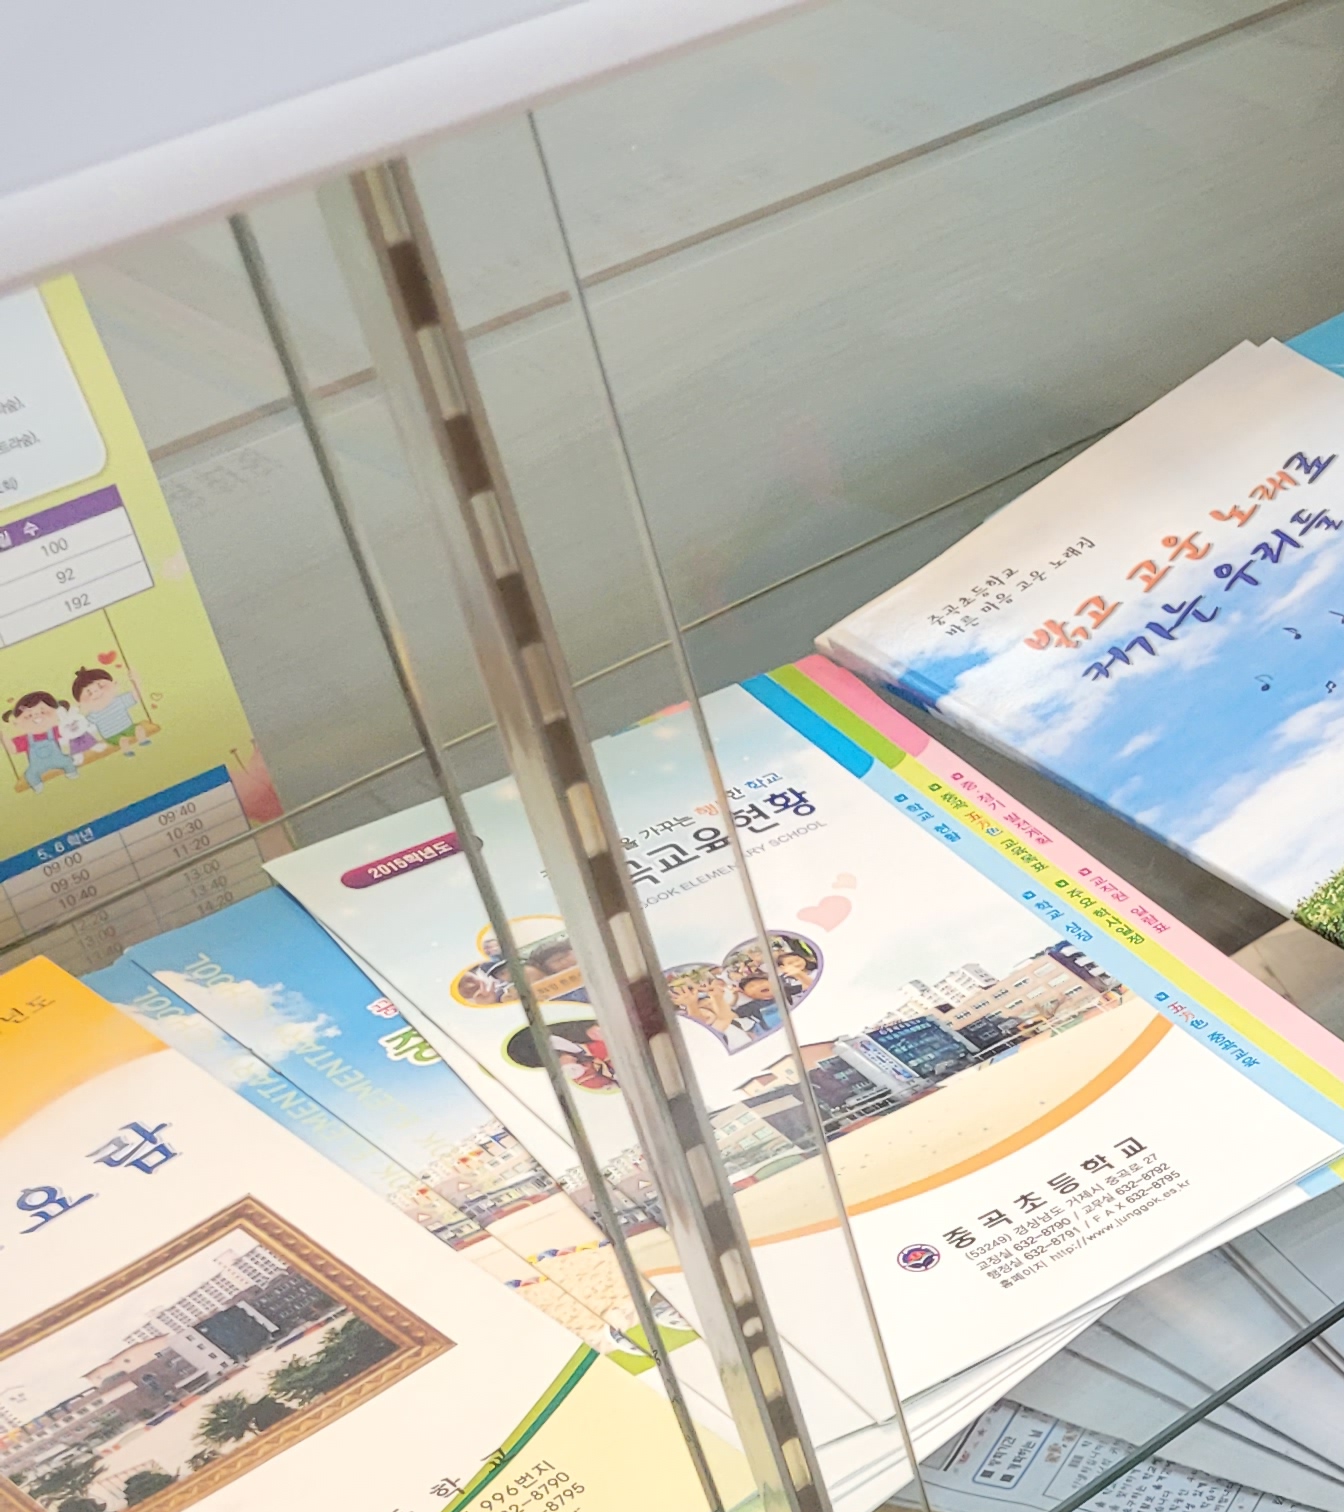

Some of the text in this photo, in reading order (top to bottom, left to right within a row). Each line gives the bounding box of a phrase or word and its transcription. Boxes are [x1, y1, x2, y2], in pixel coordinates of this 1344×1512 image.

[41, 538, 68, 557] 100
[1023, 451, 1339, 652] 밝고 고운 노래로
[56, 568, 76, 584] 92
[945, 536, 1097, 637] 바른 마음 고운 노래집
[65, 594, 91, 613] 192
[927, 567, 1020, 627] 중곡초등학교
[158, 802, 197, 827] 09:40
[639, 772, 784, 840] 가꾸는 행한 학교
[67, 828, 94, 847] 학년
[166, 818, 204, 843] 10:30
[173, 835, 211, 859] 11:20
[626, 787, 816, 886] 곡교육현황
[769, 820, 828, 848] SCHOOL
[43, 852, 83, 878] 09:00
[51, 869, 91, 895] 09:50
[905, 802, 935, 822] 학교
[1035, 900, 1065, 921] 학교
[59, 886, 98, 910] 10:40
[1066, 888, 1095, 909] 주요
[1093, 906, 1145, 945] 학사일정
[942, 1136, 1147, 1250] 중곡초등학교
[965, 1152, 1159, 1262] (53249) 경상남도 거제시 중곡로 27
[976, 1247, 1013, 1271] 교장실
[1013, 1217, 1072, 1252] 632-8790
[1081, 1192, 1116, 1215] 교무실
[1115, 1162, 1171, 1196] 632-8792
[986, 1257, 1024, 1281] 행정실
[1023, 1227, 1082, 1262] 632-8791
[1125, 1170, 1181, 1205] 632-8795
[999, 1260, 1049, 1290] 홈페이지
[480, 1460, 556, 1512] 996번지
